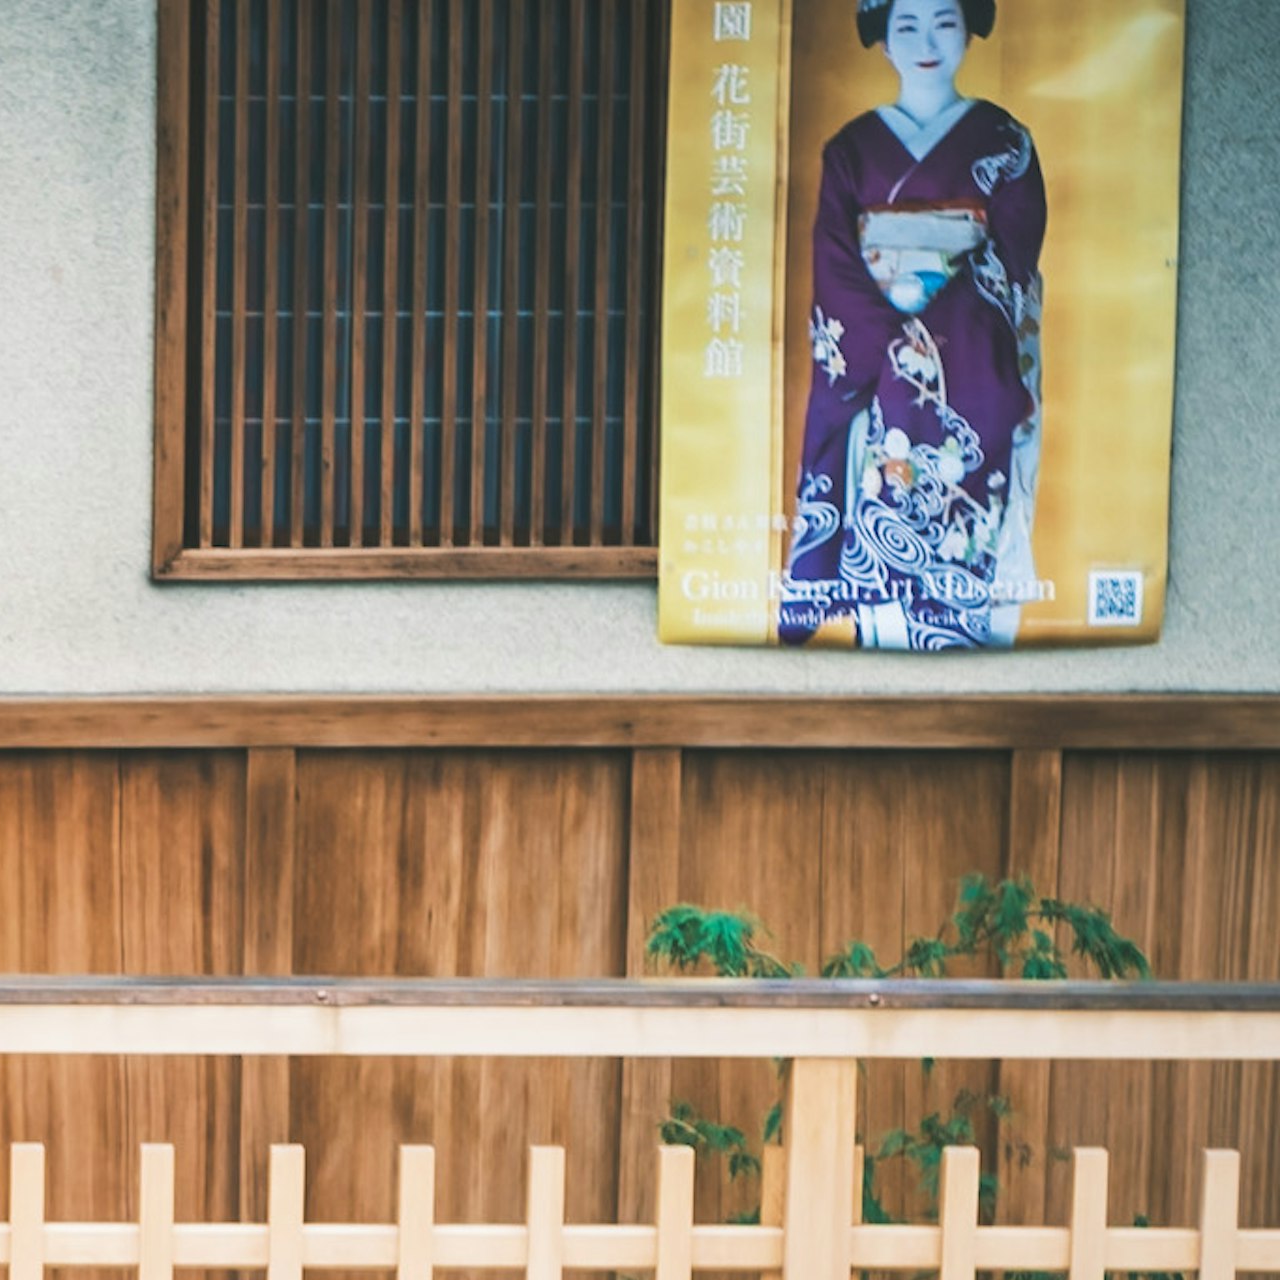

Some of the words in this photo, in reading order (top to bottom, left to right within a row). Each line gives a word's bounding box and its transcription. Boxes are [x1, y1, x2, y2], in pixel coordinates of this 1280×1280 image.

[680, 571, 758, 601] Gion
[920, 570, 1057, 602] Museum
[775, 607, 825, 626] World
